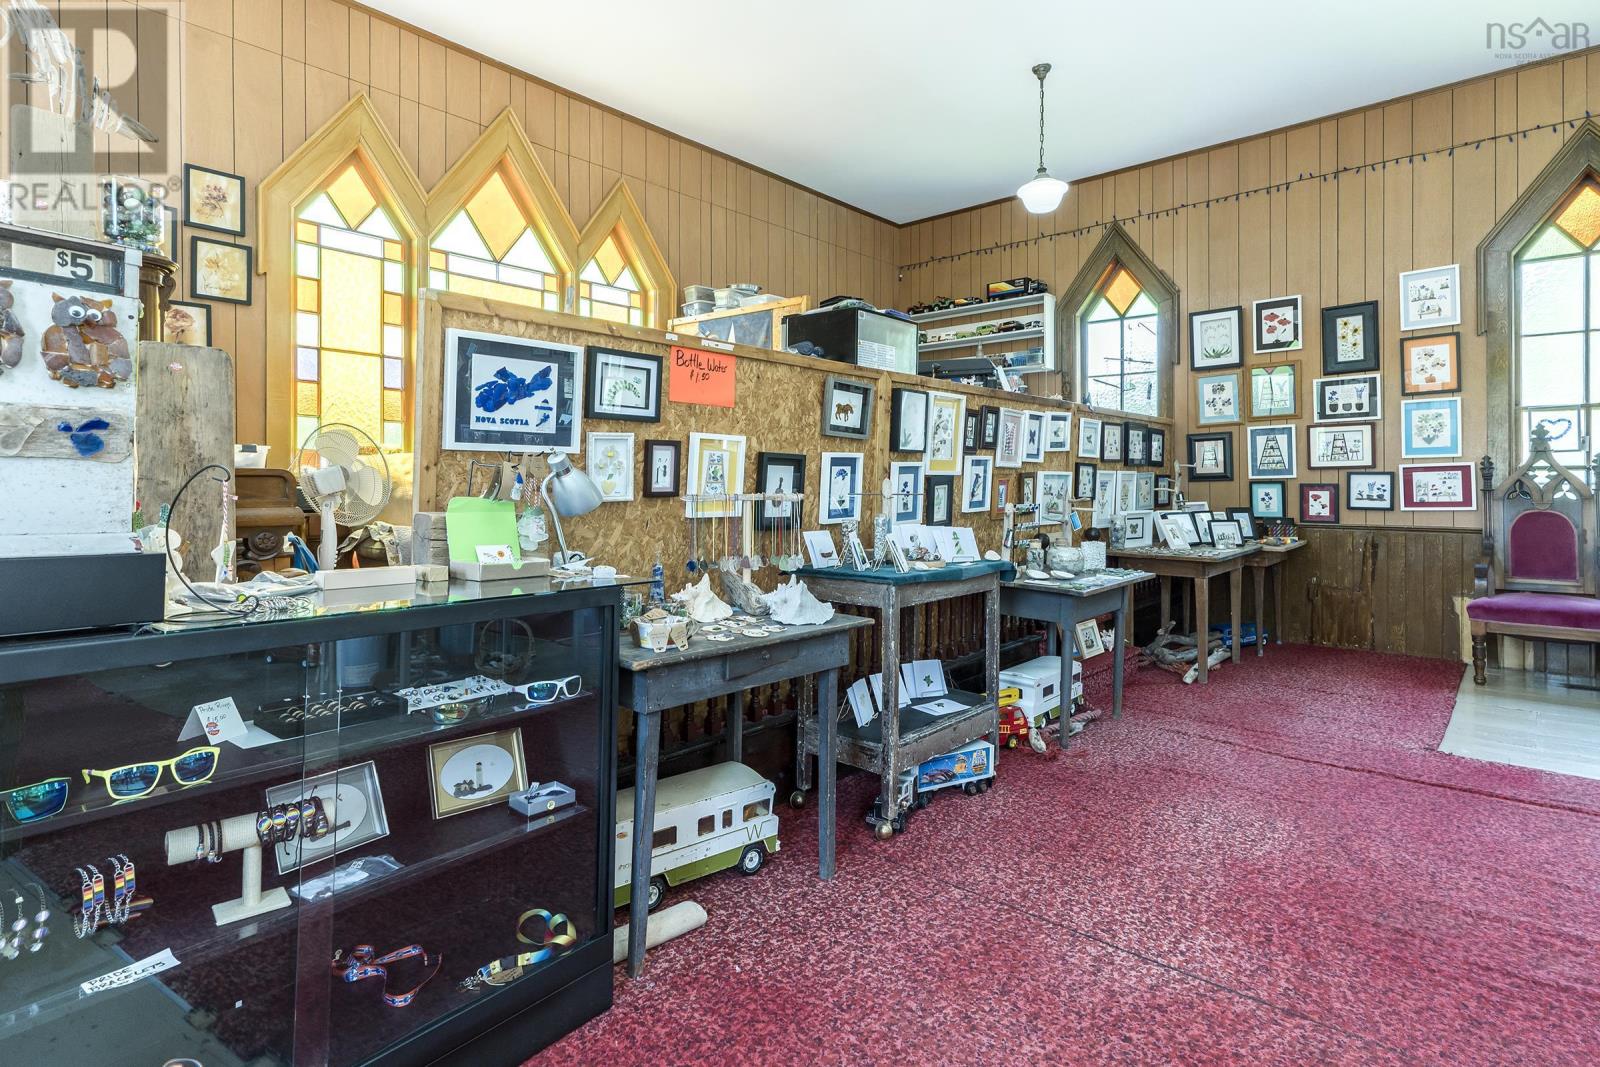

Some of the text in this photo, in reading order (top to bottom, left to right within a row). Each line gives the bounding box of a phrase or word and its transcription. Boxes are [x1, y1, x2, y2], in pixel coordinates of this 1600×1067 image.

[57, 250, 94, 282] $5
[676, 348, 706, 370] Bottle
[475, 415, 530, 426] NOVA SCOTIA
[88, 966, 133, 986] PRIDE
